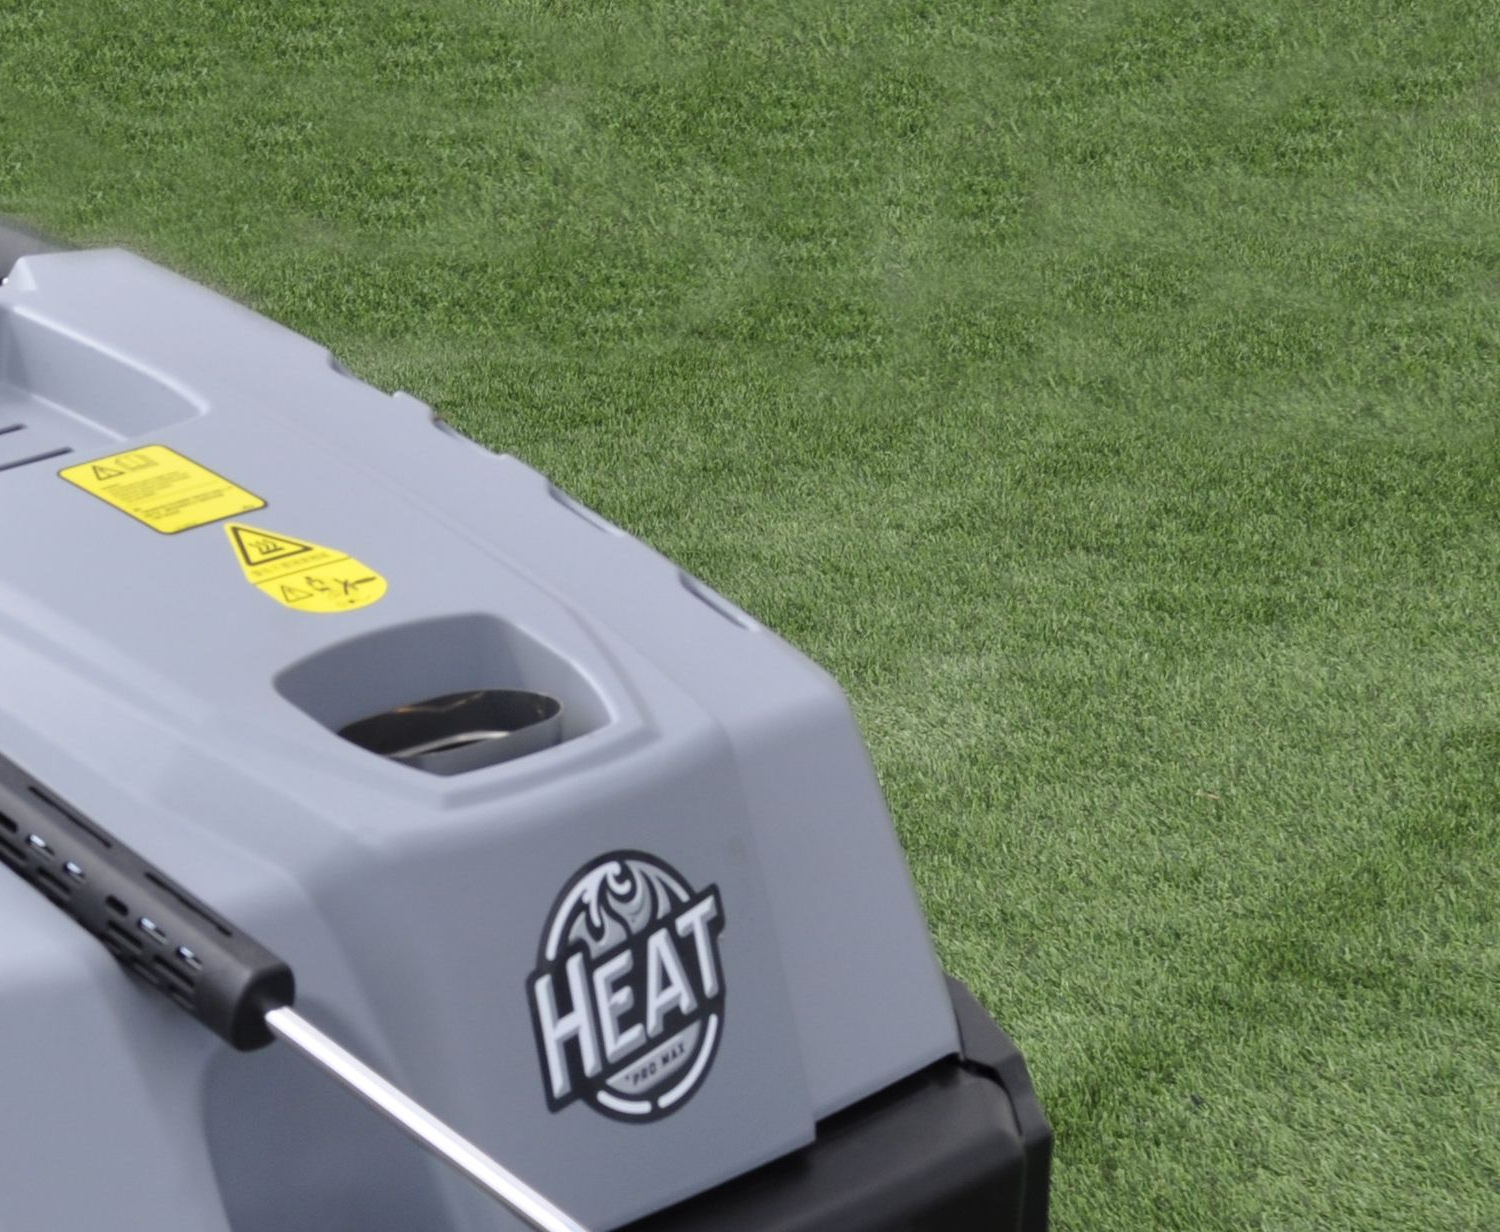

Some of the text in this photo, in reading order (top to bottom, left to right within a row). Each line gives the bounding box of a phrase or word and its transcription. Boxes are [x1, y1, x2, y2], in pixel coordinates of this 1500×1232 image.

[534, 894, 719, 1100] HEAT
[631, 1042, 685, 1087] PRO MAX
